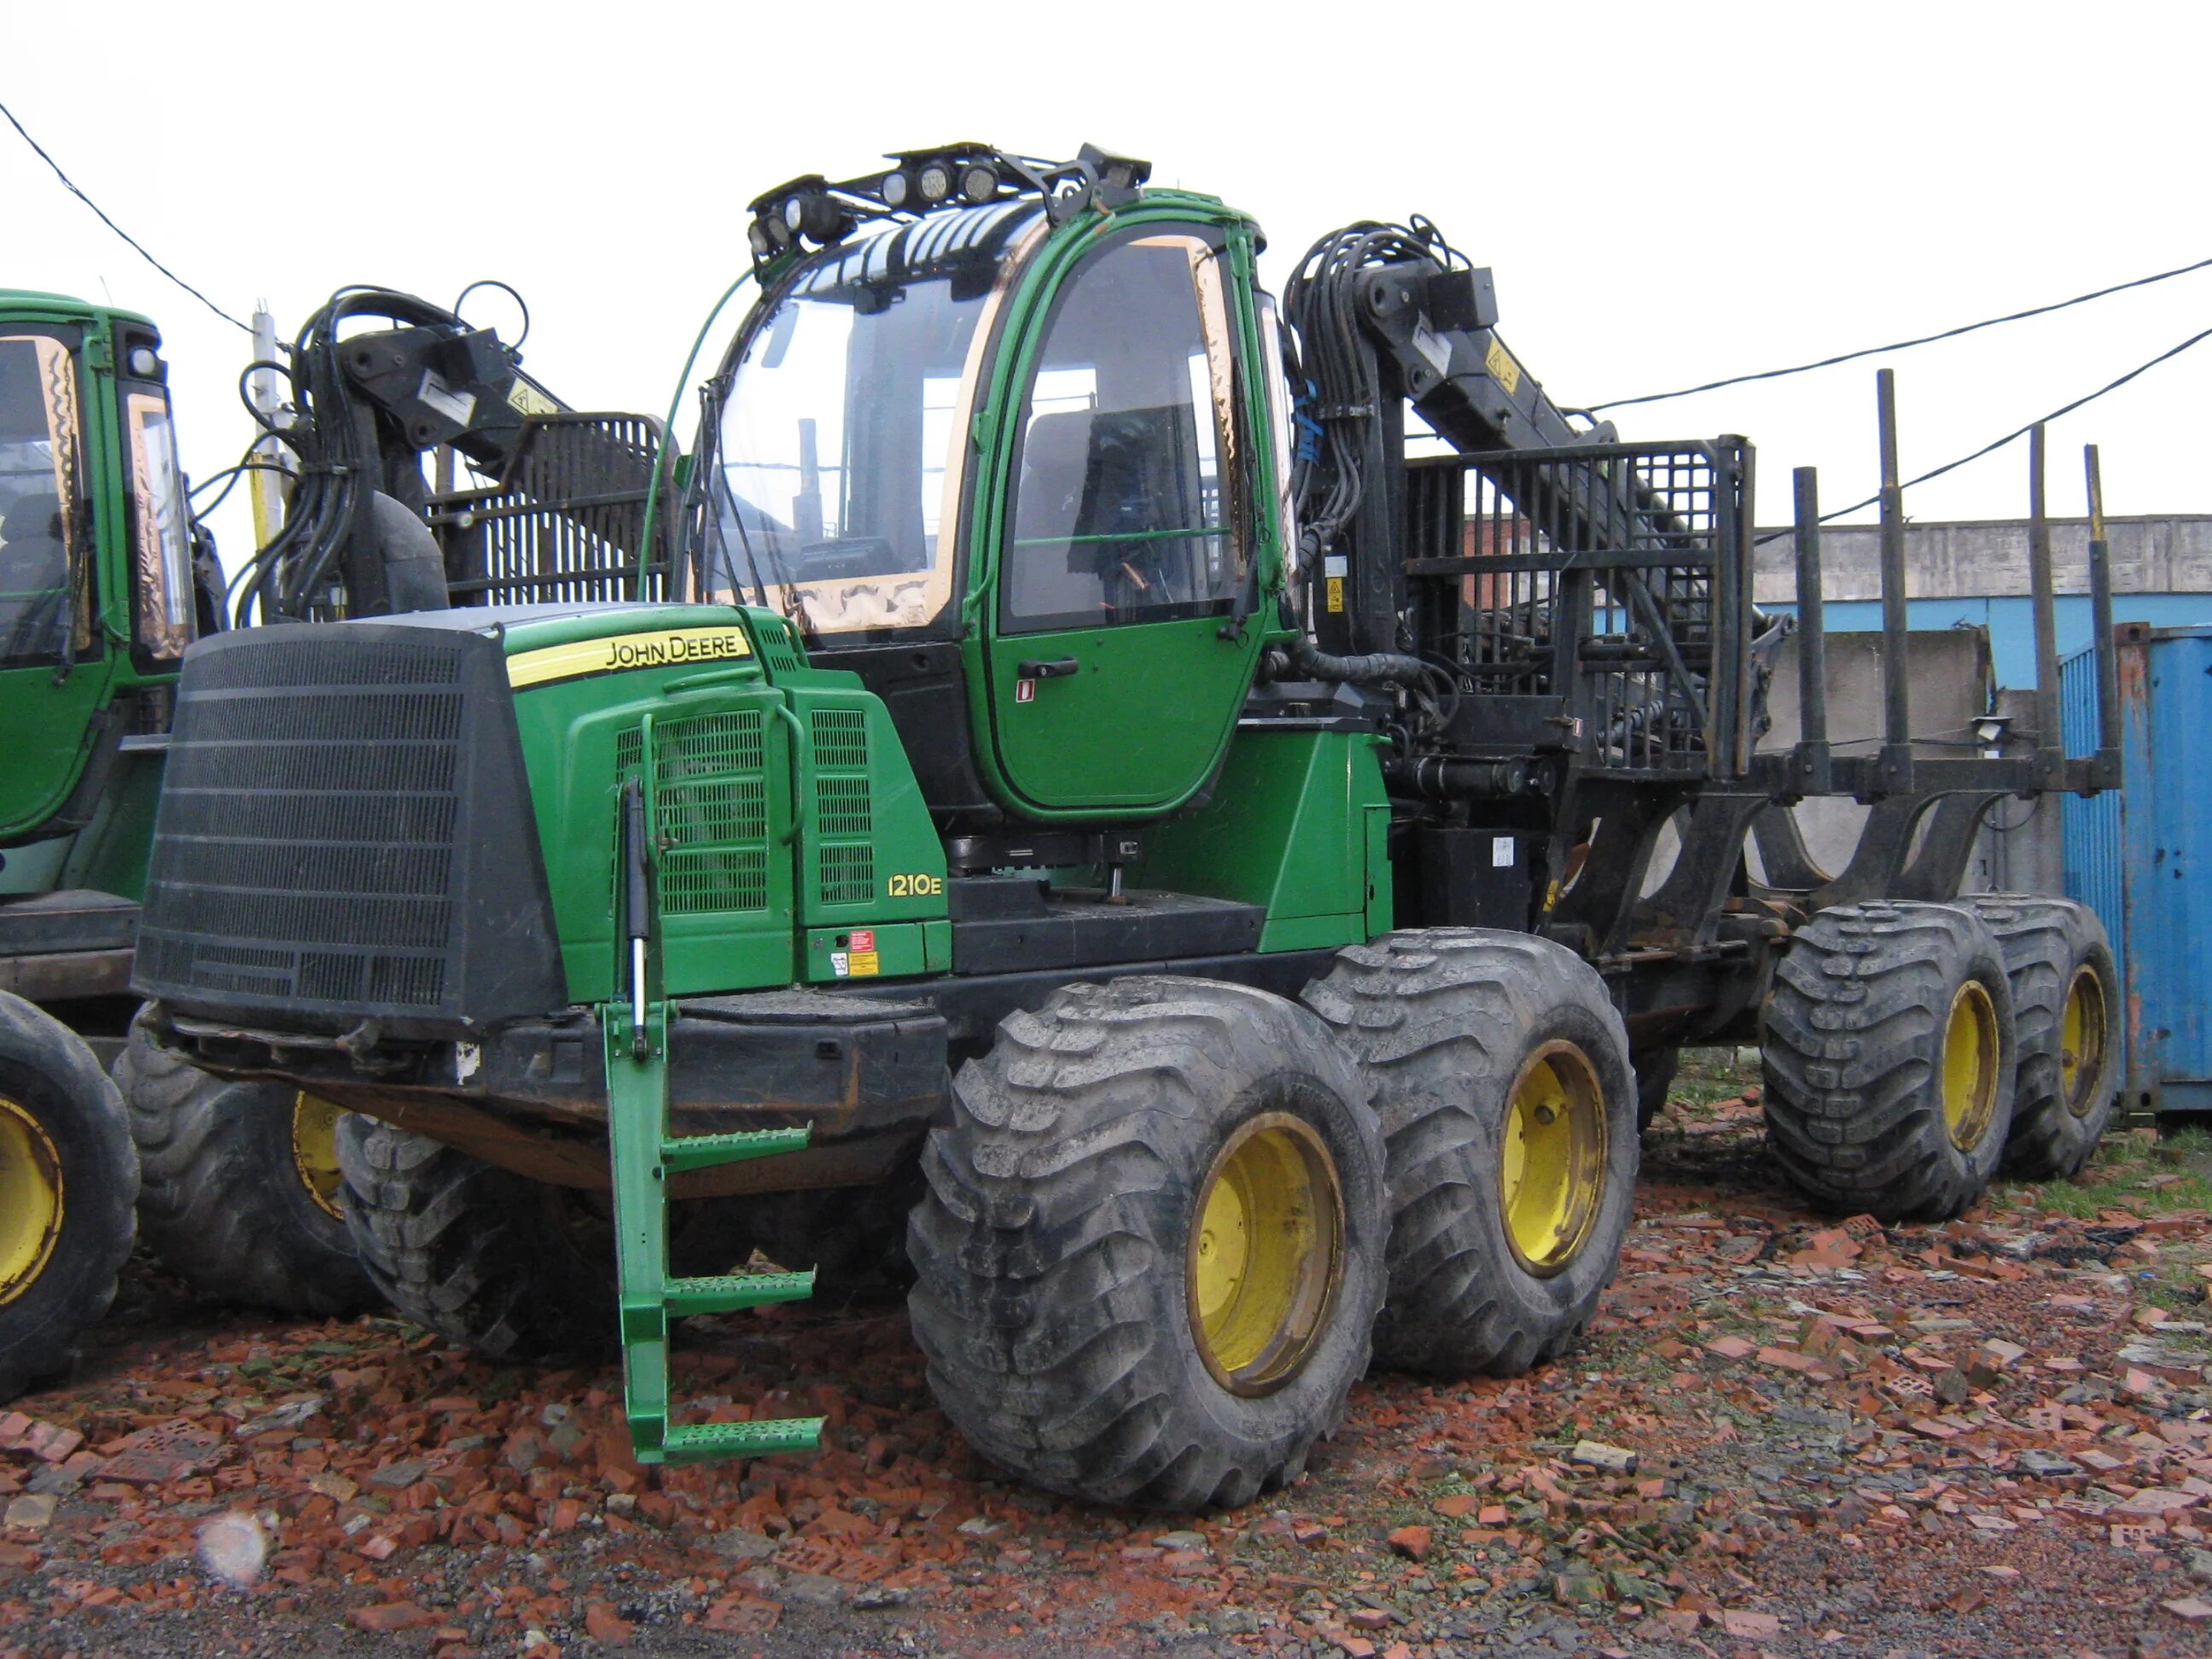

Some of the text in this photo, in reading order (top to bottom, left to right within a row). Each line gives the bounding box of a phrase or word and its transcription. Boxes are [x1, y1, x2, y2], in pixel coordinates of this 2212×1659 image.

[606, 636, 737, 666] JOHN DEERE
[888, 873, 942, 897] 1210E
